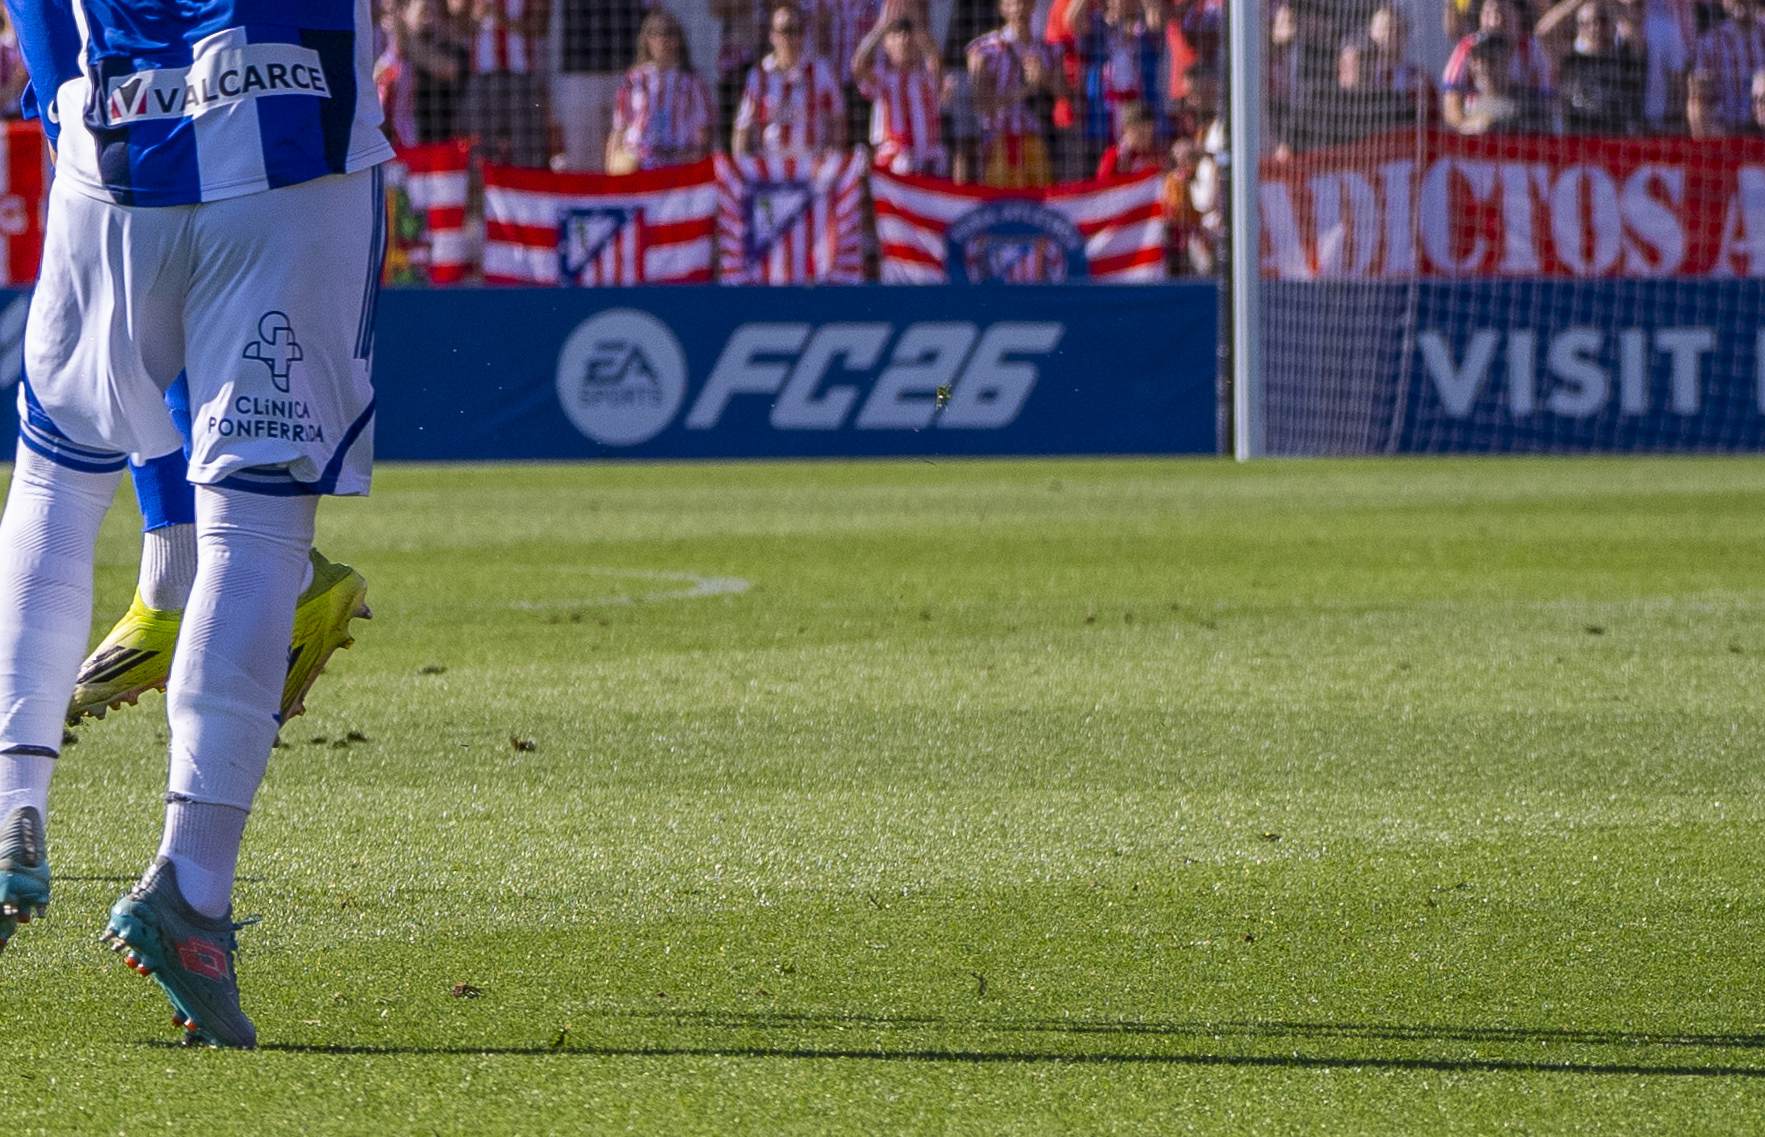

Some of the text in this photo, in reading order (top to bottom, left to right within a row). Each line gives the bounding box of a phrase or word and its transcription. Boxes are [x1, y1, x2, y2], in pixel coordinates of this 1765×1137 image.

[153, 62, 326, 113] VALCARCE
[586, 341, 659, 386] EA
[1418, 327, 1715, 419] VISIT
